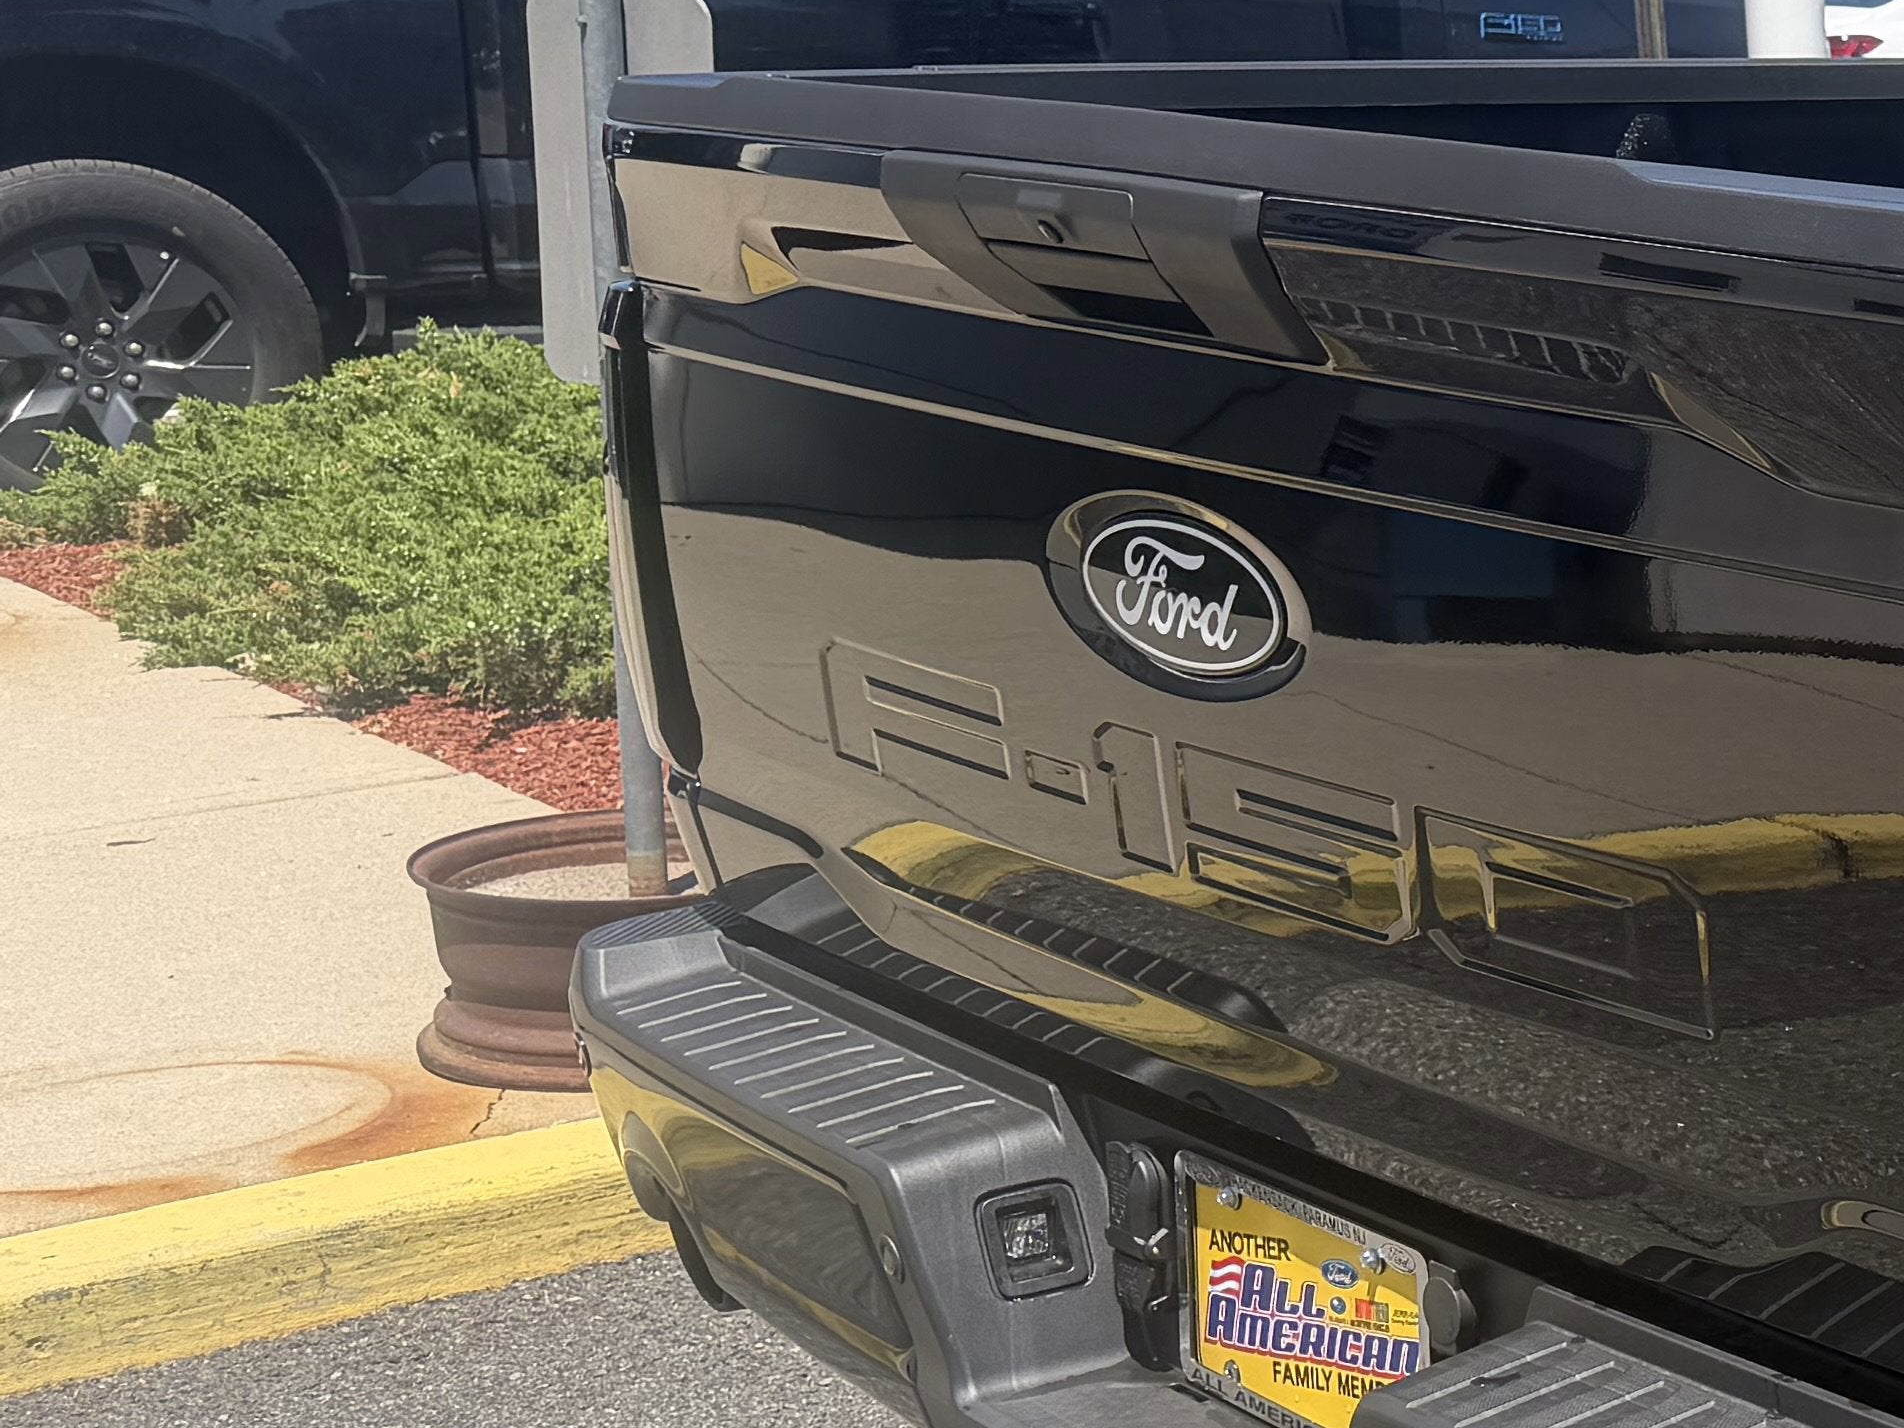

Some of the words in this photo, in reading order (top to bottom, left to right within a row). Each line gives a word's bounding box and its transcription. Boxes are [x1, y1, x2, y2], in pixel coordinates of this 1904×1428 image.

[1115, 534, 1238, 651] Ford
[817, 636, 1718, 1042] F-150
[1209, 1228, 1291, 1261] ANOTHER
[1353, 1227, 1366, 1245] NJ
[1327, 1263, 1352, 1284] Ford
[1192, 1367, 1229, 1399] ALL
[1272, 1360, 1331, 1392] FAMILY
